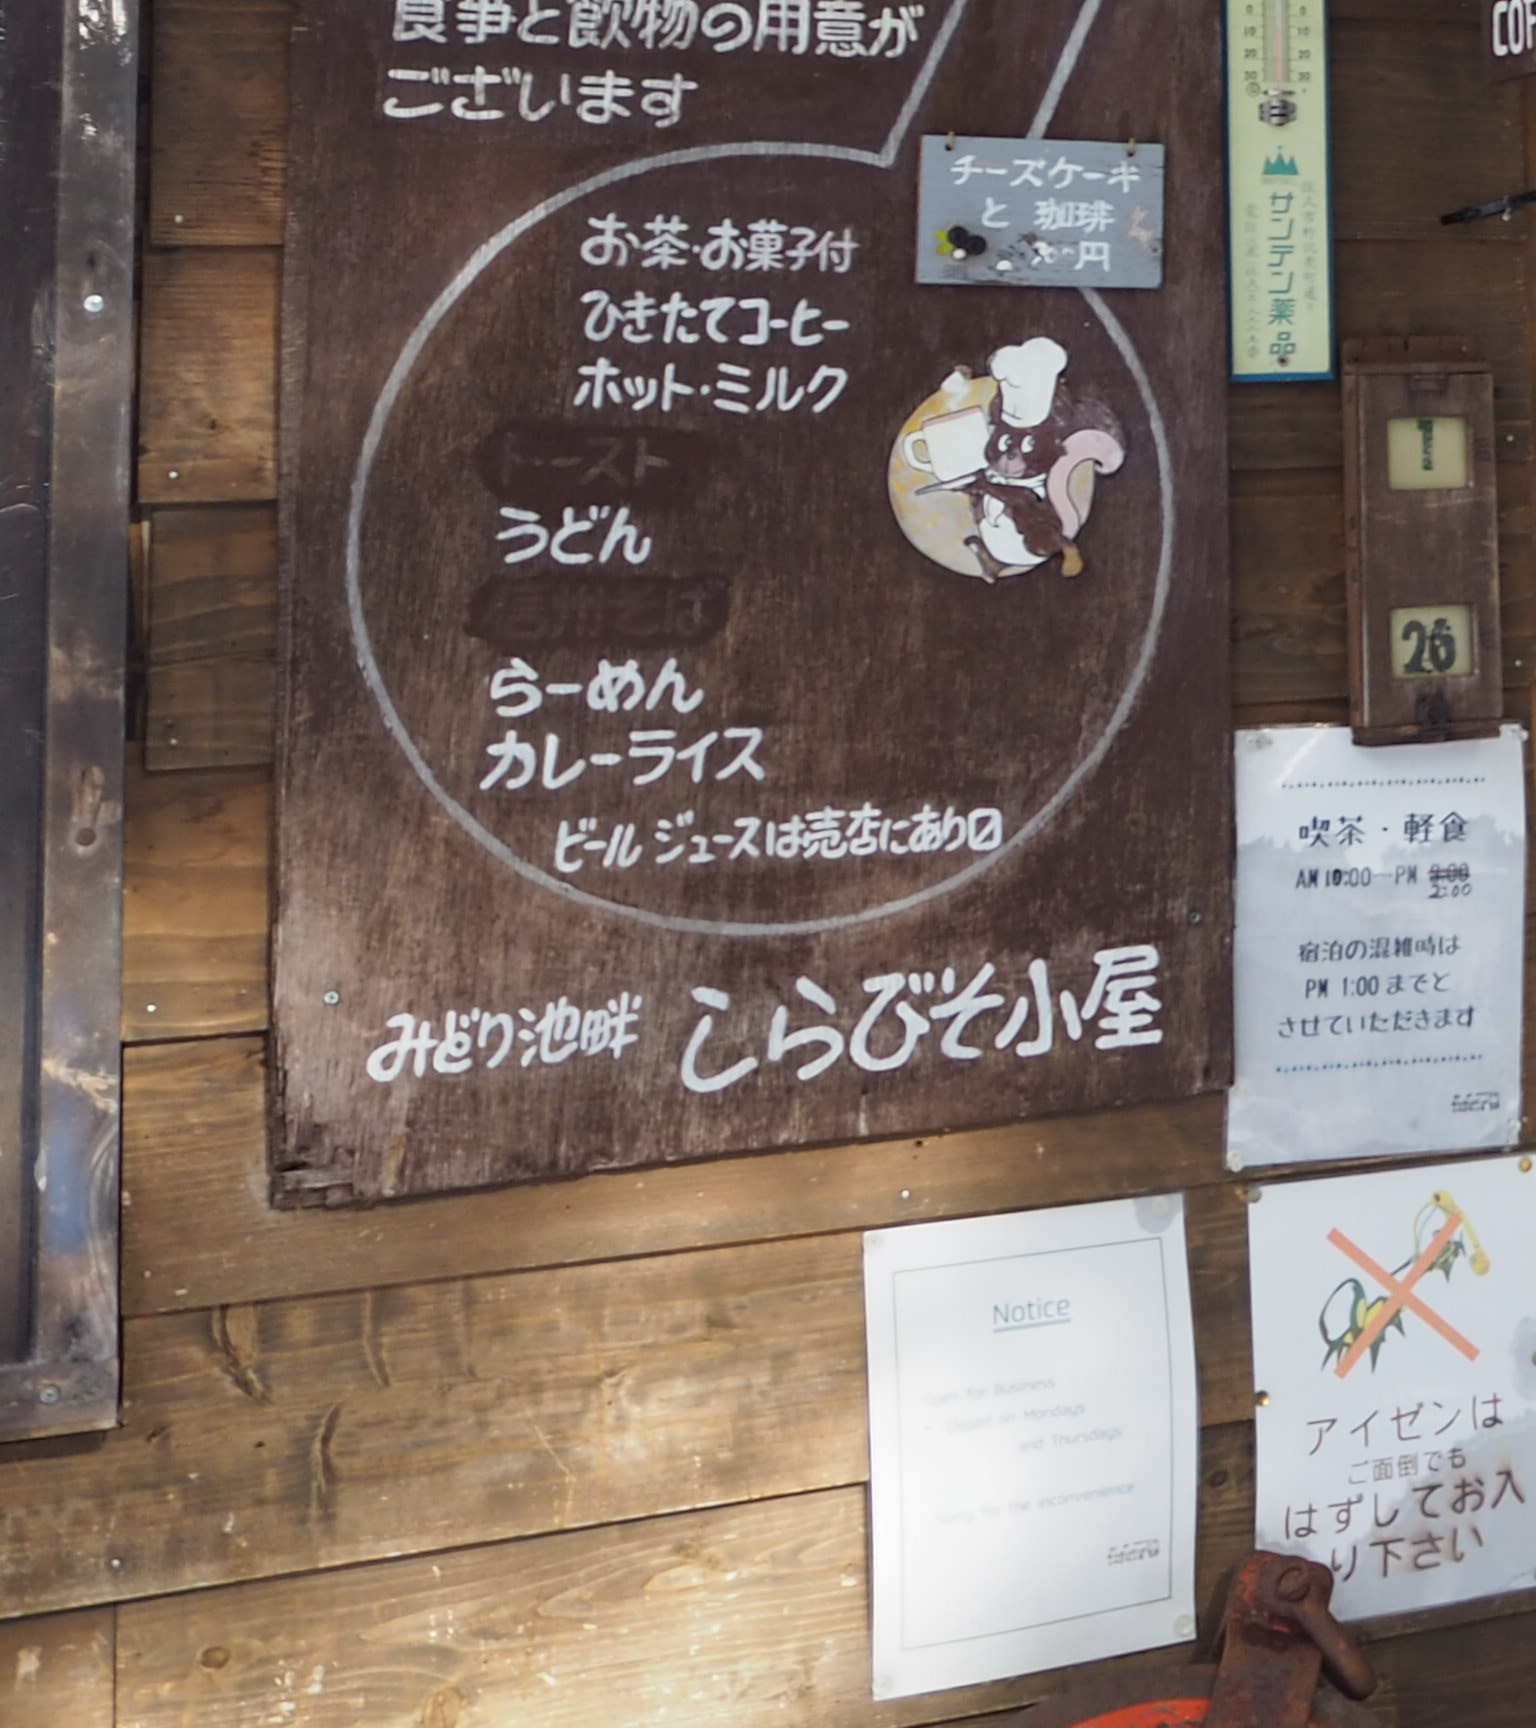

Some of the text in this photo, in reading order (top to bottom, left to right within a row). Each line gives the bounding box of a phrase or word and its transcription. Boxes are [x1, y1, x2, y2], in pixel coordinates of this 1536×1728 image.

[382, 66, 698, 128] ございます
[950, 154, 1140, 193] チーズケーキ
[981, 196, 1115, 232] と 珈琲
[1265, 191, 1297, 356] サンテン薬品
[582, 289, 850, 345] ひきたてコーヒー
[1416, 418, 1434, 471] 1
[494, 503, 652, 566] うどん
[1401, 617, 1457, 674] 26
[489, 658, 704, 717] らーめん
[479, 725, 766, 791] カレーライス
[555, 818, 639, 872] ビール
[1299, 810, 1470, 847] 喫茶・軽食
[1298, 934, 1461, 964] 宿泊の混雑時は
[1305, 971, 1451, 999] PM 1:00 までと
[366, 992, 642, 1082] みどり池畔
[679, 942, 1163, 1094] しらびそ小屋
[1277, 1005, 1476, 1040] させていただきます
[991, 1294, 1072, 1327] Notice
[994, 1376, 1057, 1398] Business
[1023, 1401, 1087, 1422] Mondays
[1017, 1424, 1123, 1453] and Thursdays
[1306, 1390, 1504, 1456] アイゼンは
[1346, 1445, 1467, 1486] ご面倒でも
[1008, 1498, 1031, 1513] the
[1285, 1469, 1526, 1541] はずしてお入
[1330, 1525, 1485, 1583] り下さい
